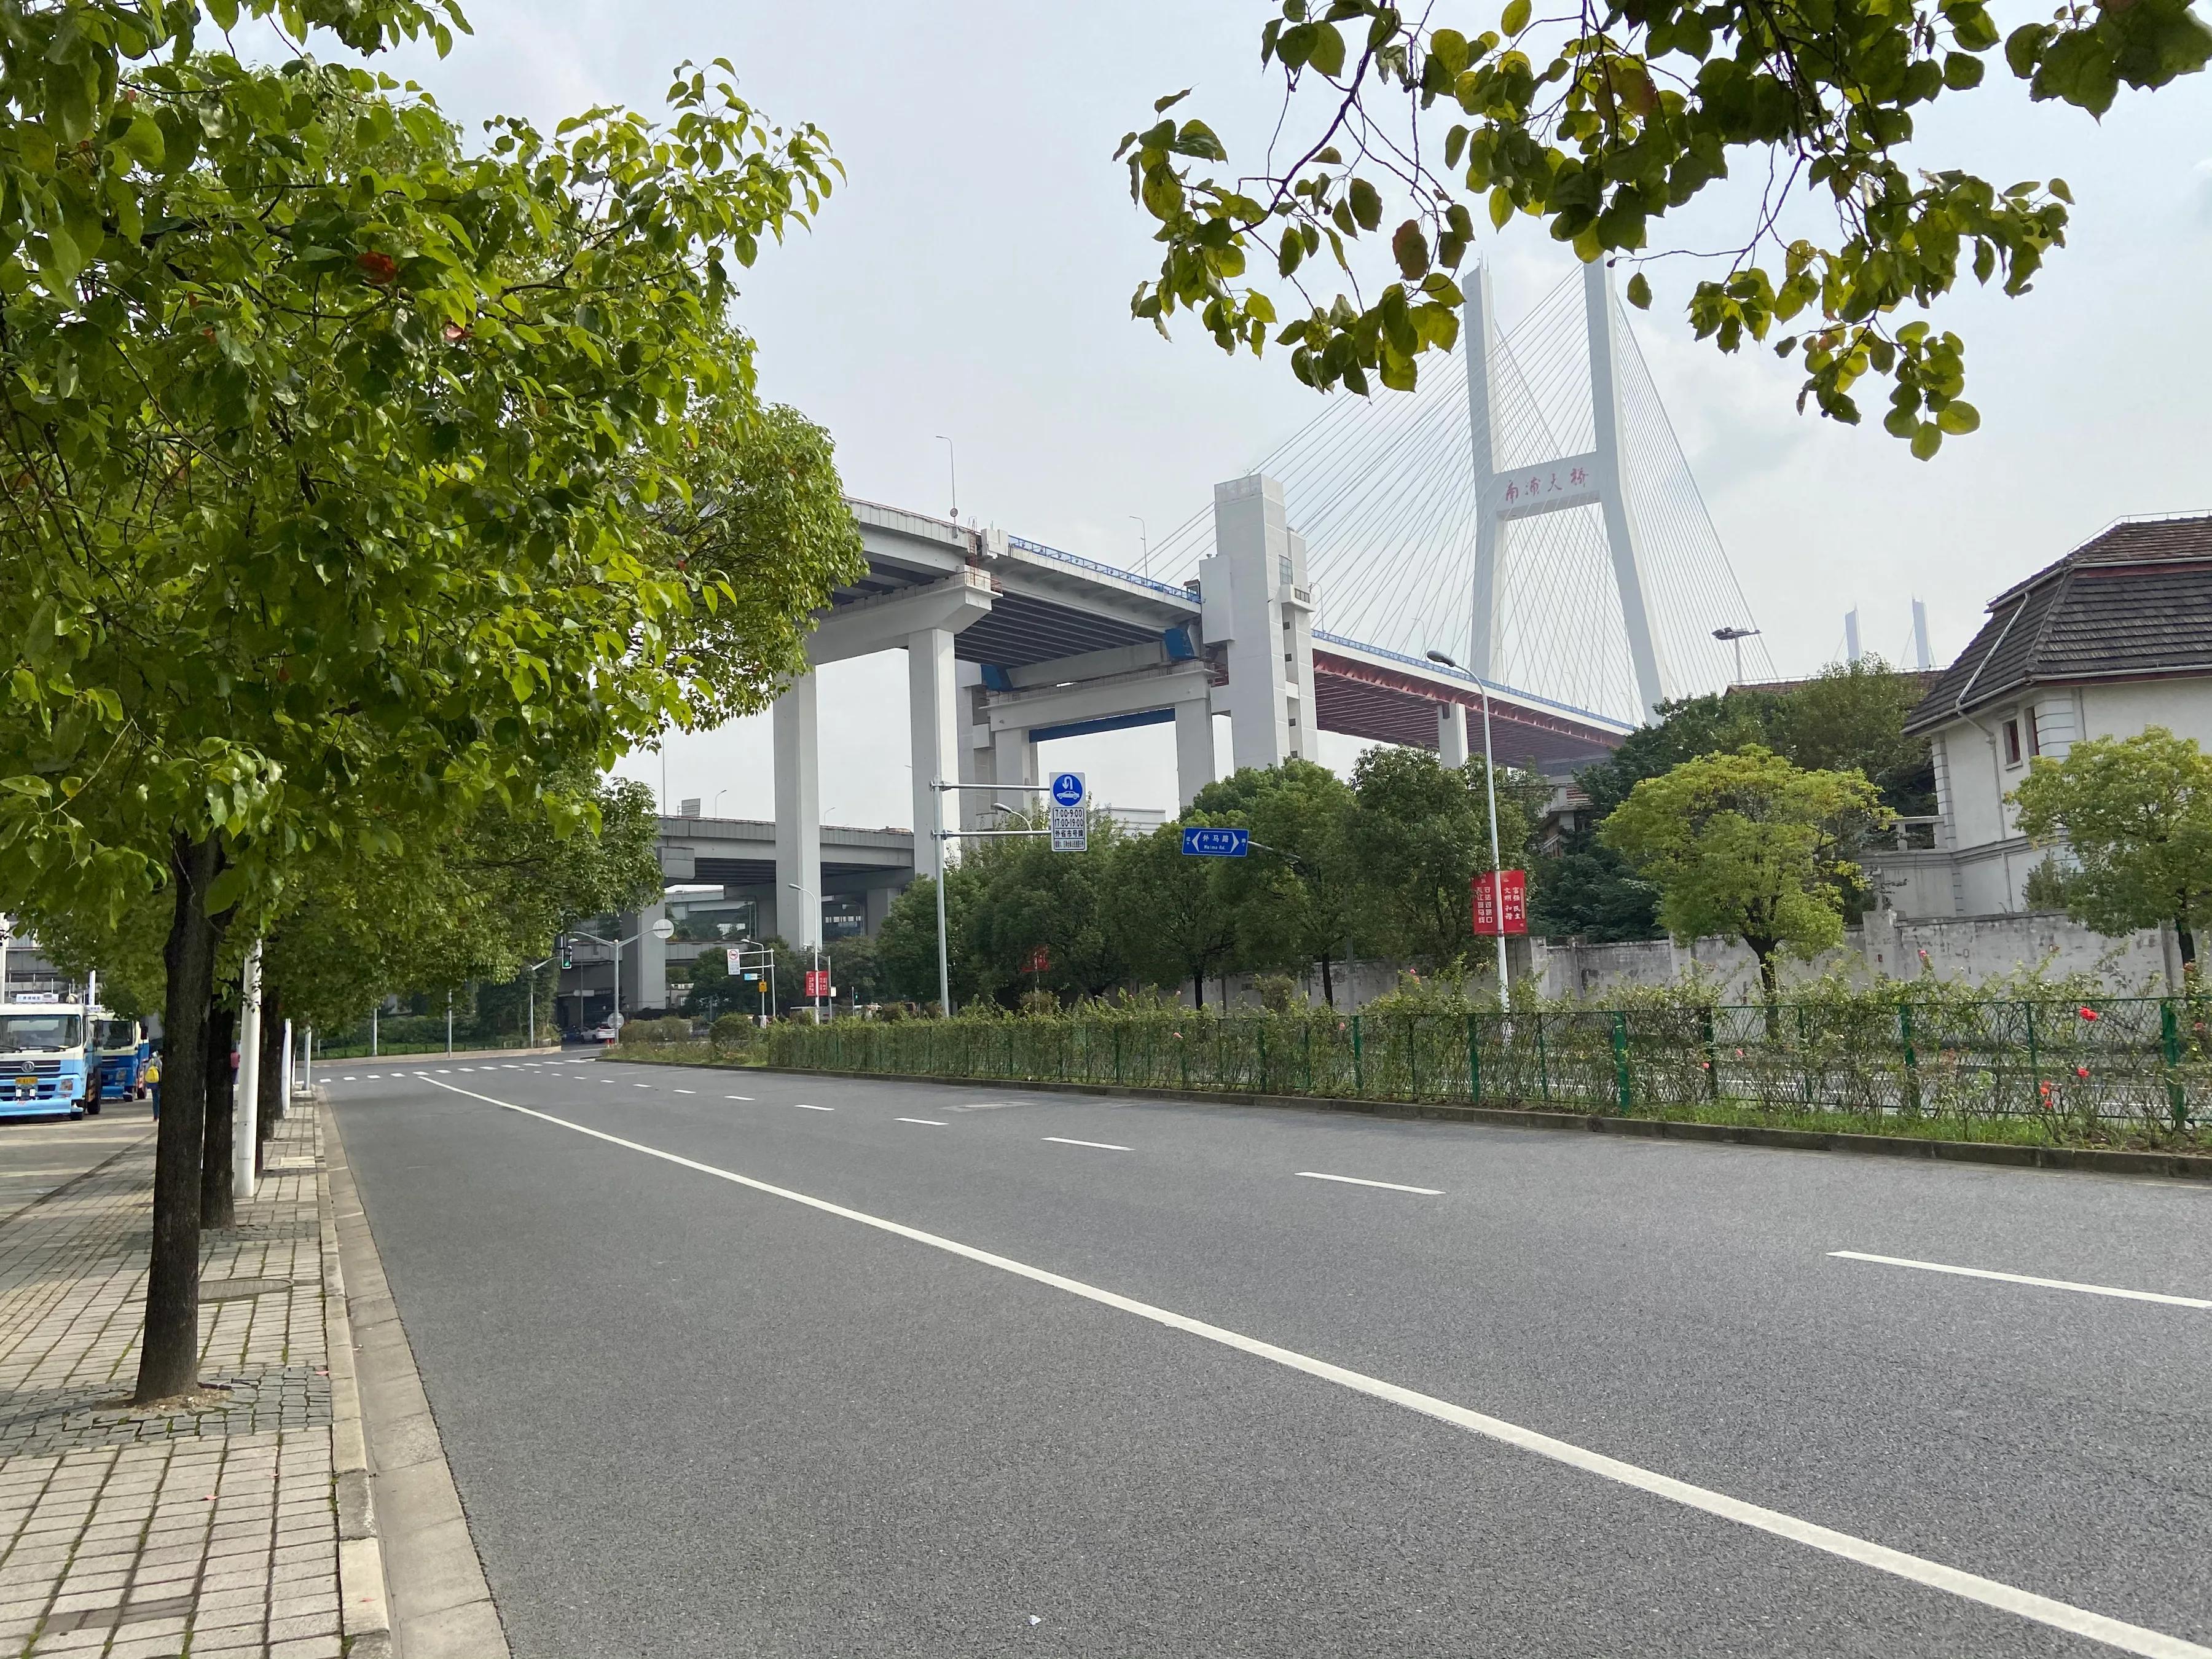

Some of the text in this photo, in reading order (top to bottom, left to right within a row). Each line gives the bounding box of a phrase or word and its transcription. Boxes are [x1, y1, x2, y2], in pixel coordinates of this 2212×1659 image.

[1506, 467, 1589, 504] 南浦大桥
[1504, 887, 1513, 920] 文明 和谐
[1512, 887, 1521, 919] 富强 民主
